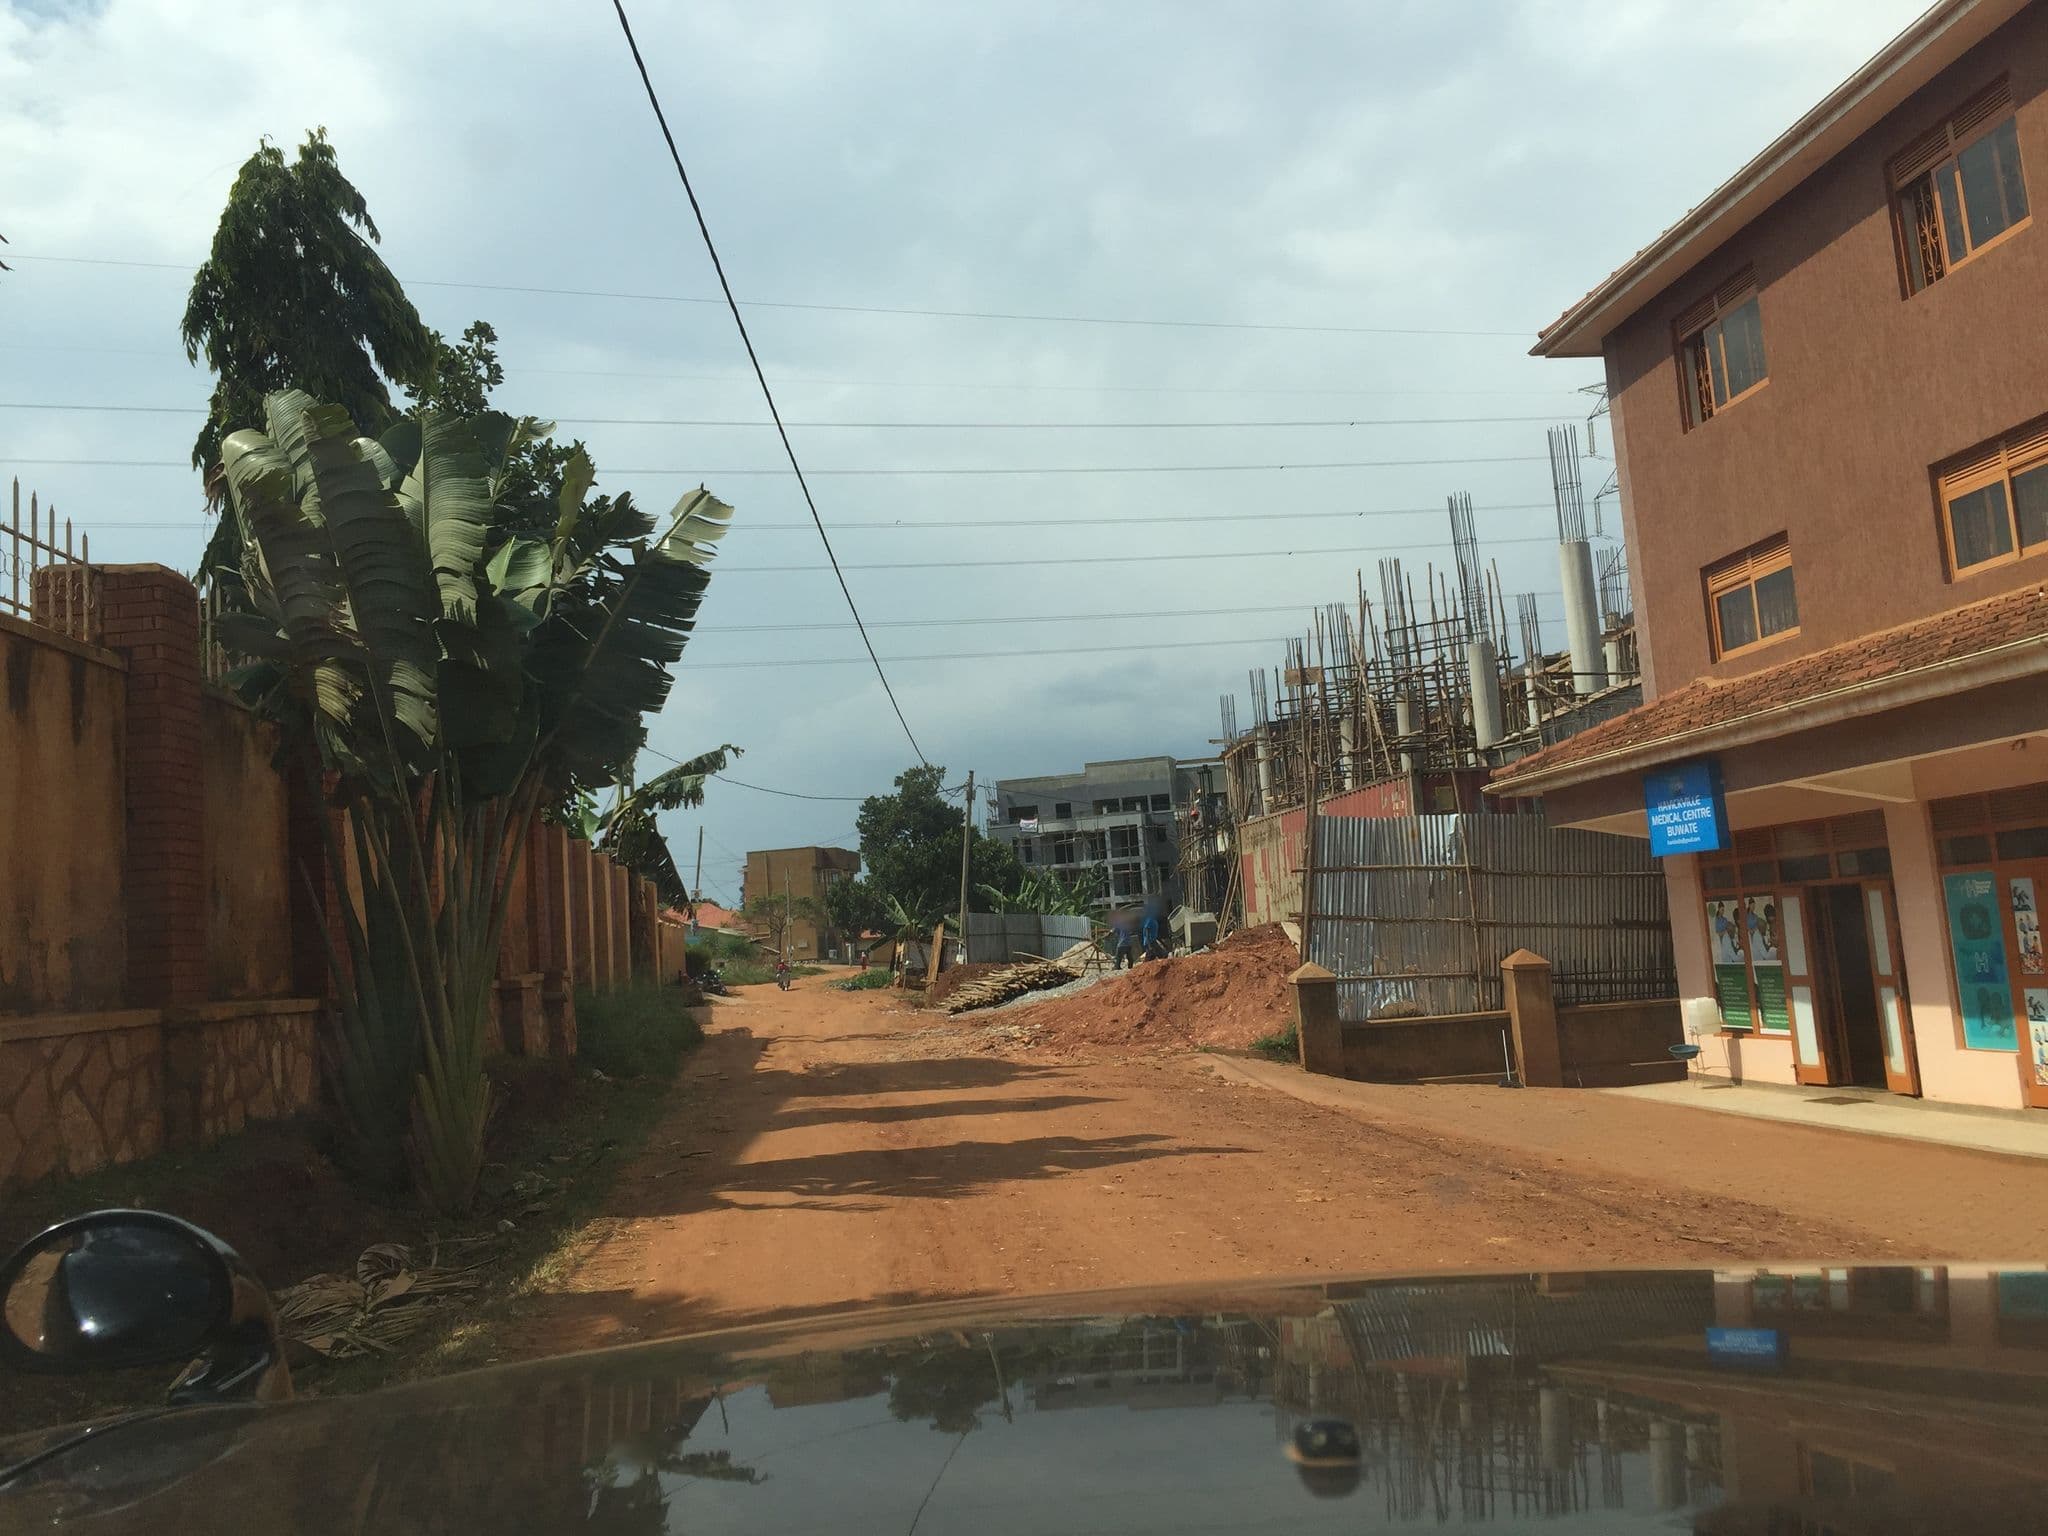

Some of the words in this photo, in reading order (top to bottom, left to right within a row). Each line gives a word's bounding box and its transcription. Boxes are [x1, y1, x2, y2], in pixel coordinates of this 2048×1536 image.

[1652, 813, 1682, 826] MEDICAL
[1683, 807, 1711, 821] CENTRE
[1667, 823, 1698, 836] BUWATE
